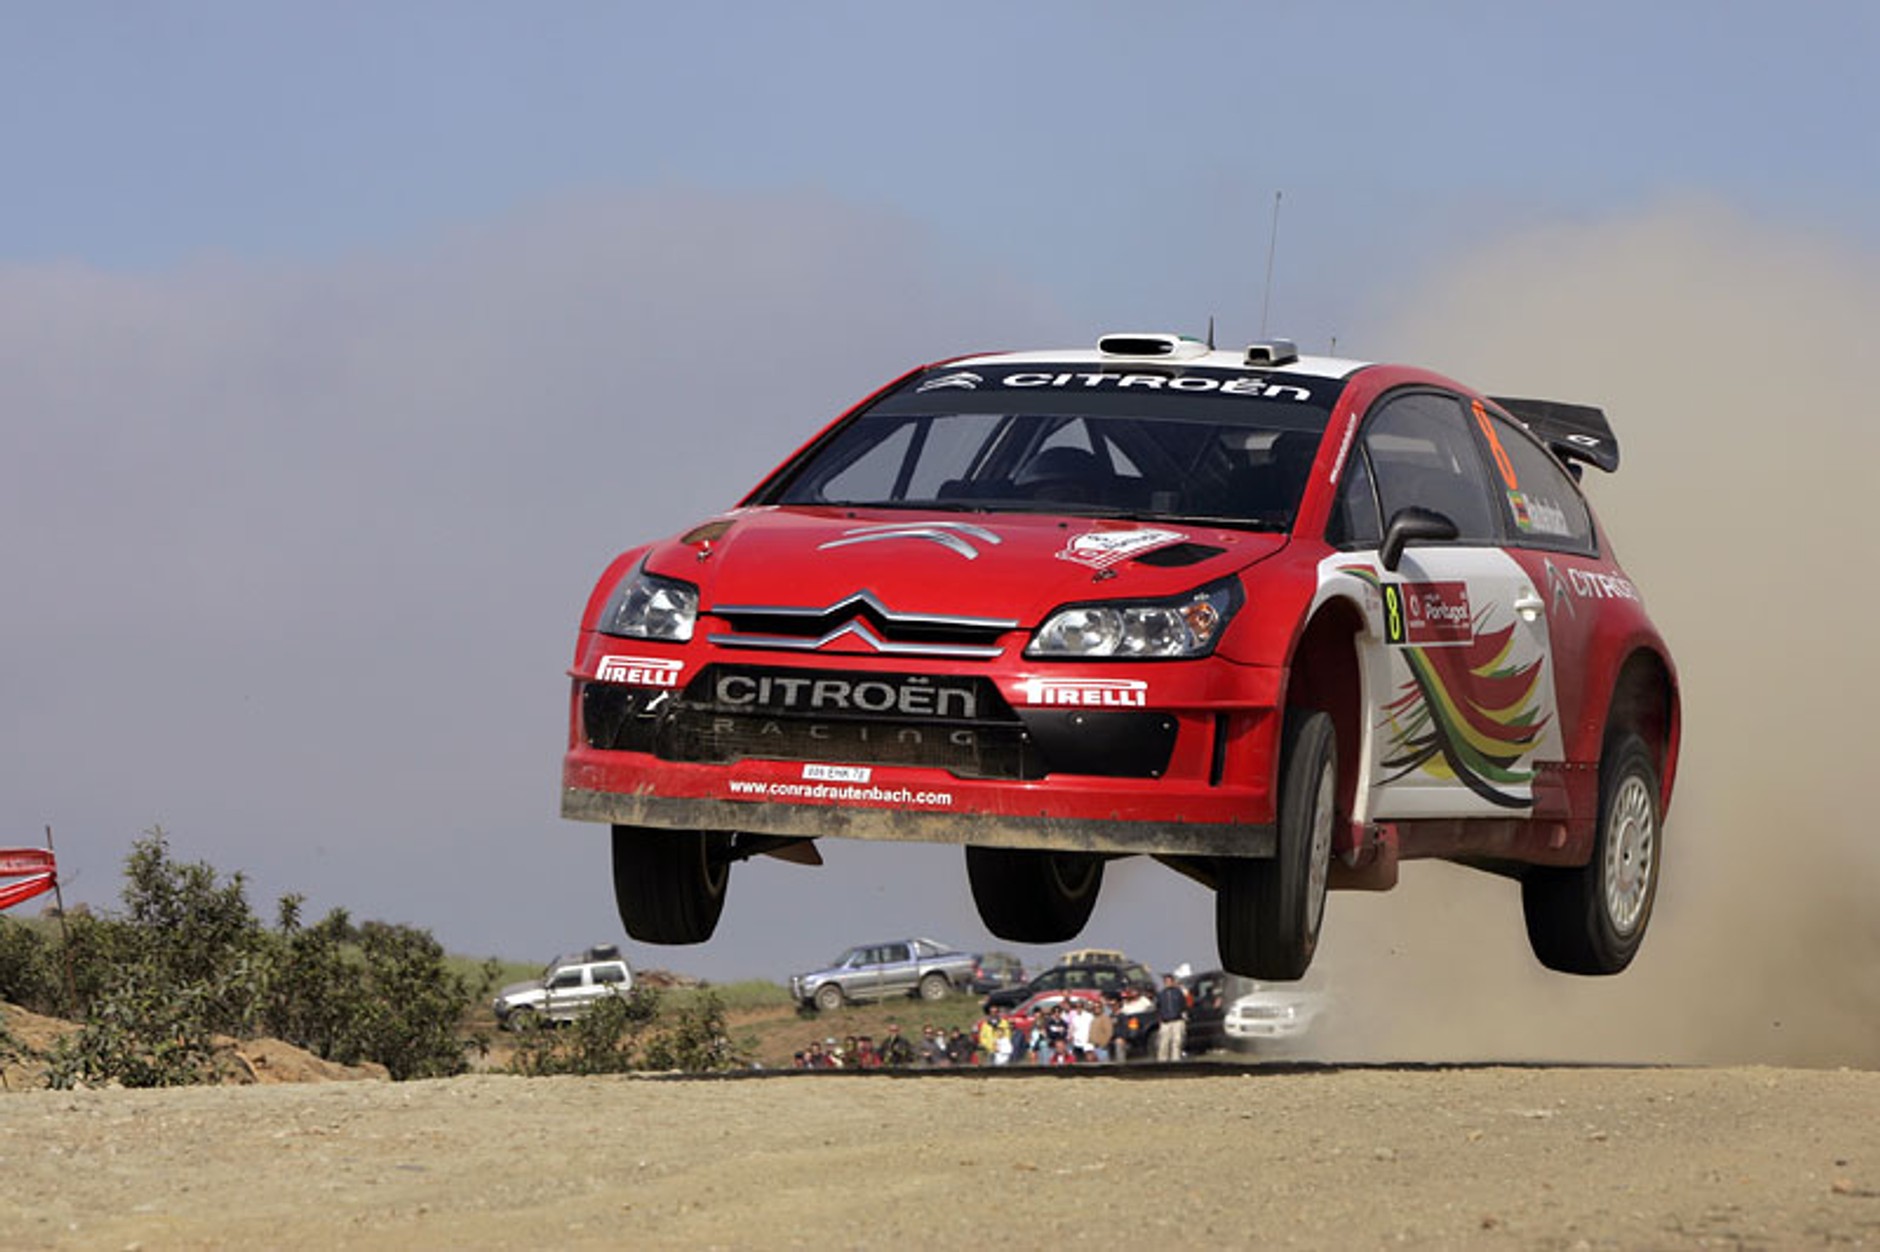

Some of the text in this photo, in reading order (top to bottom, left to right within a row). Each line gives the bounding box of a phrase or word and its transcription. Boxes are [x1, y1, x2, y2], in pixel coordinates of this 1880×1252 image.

[1386, 586, 1401, 641] 8
[1425, 602, 1468, 622] Portugal
[595, 654, 685, 687] PIRELLI
[1025, 678, 1148, 707] PIRELLI
[729, 780, 953, 805] www.conradrautenbach.com
